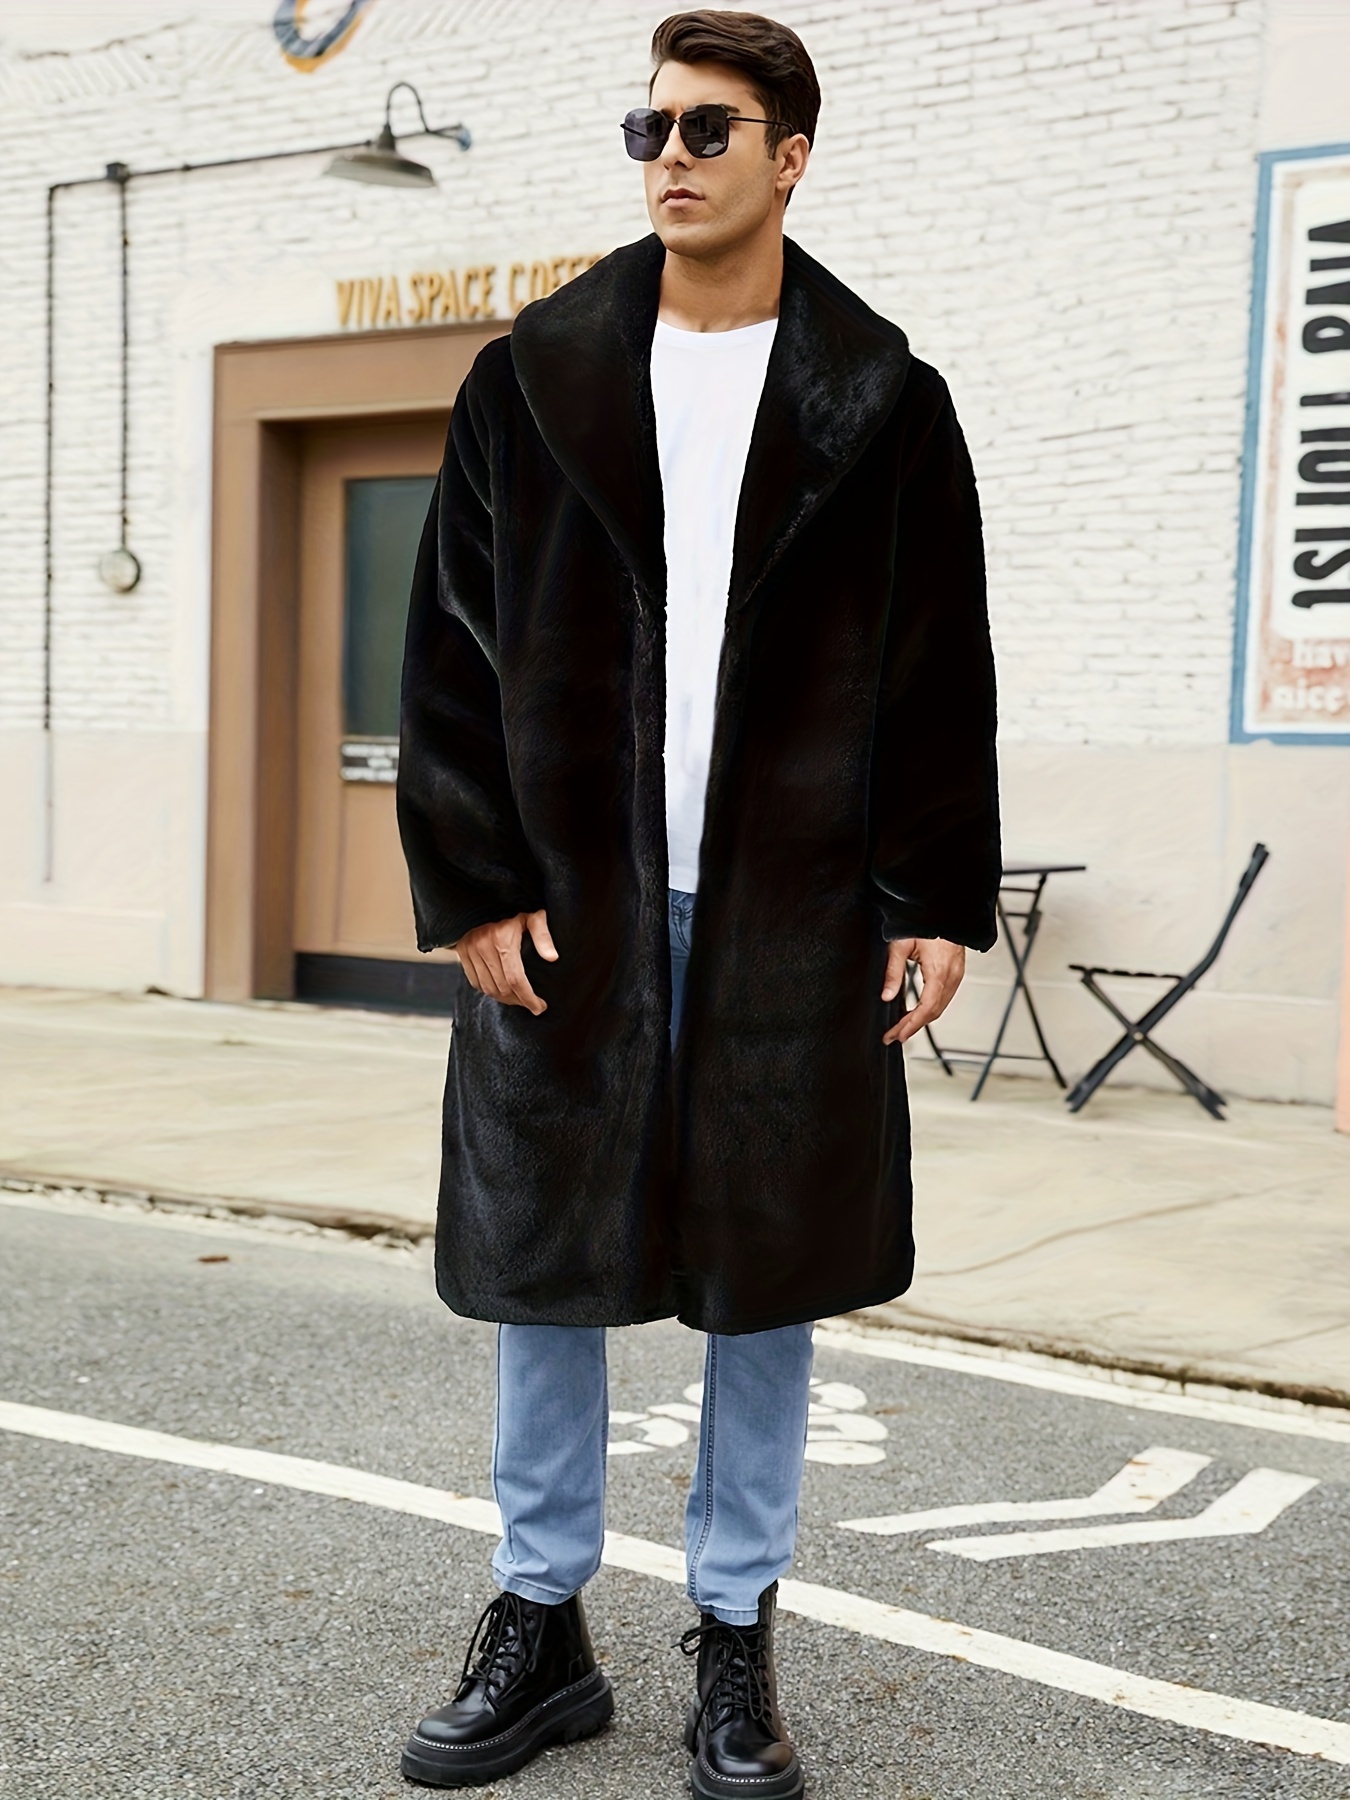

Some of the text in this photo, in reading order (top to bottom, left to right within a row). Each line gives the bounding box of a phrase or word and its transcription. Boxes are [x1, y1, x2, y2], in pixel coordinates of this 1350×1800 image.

[336, 254, 603, 327] VIVA SPACE COF
